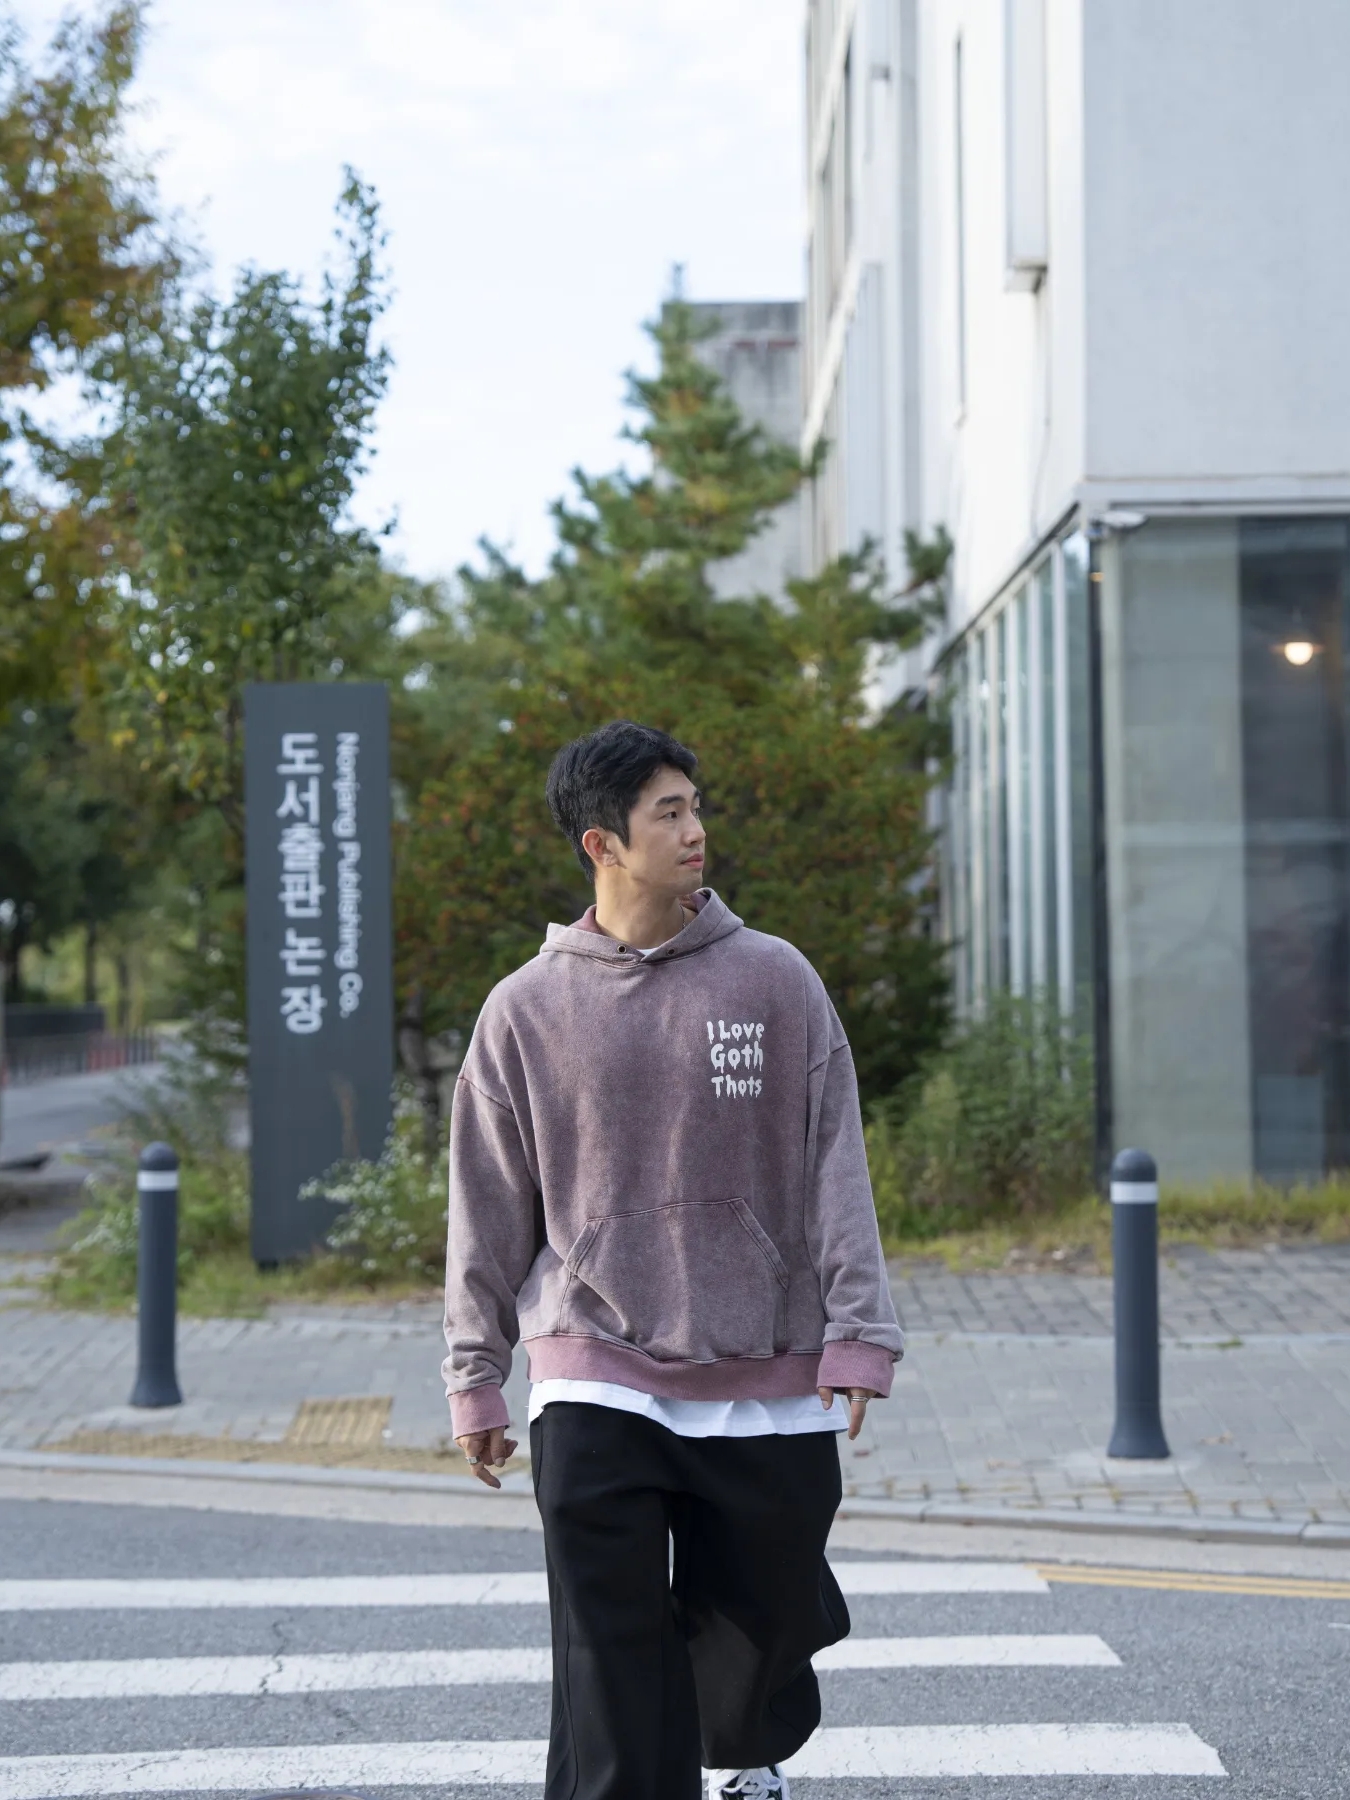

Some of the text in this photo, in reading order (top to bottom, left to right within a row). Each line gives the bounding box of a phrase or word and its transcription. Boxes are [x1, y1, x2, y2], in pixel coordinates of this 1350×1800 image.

[276, 732, 326, 919] 도서출판
[332, 732, 363, 1018] Nonjang Publishing Co.
[706, 1019, 764, 1044] I Love
[710, 1041, 763, 1074] Goth
[711, 1074, 762, 1098] Thots
